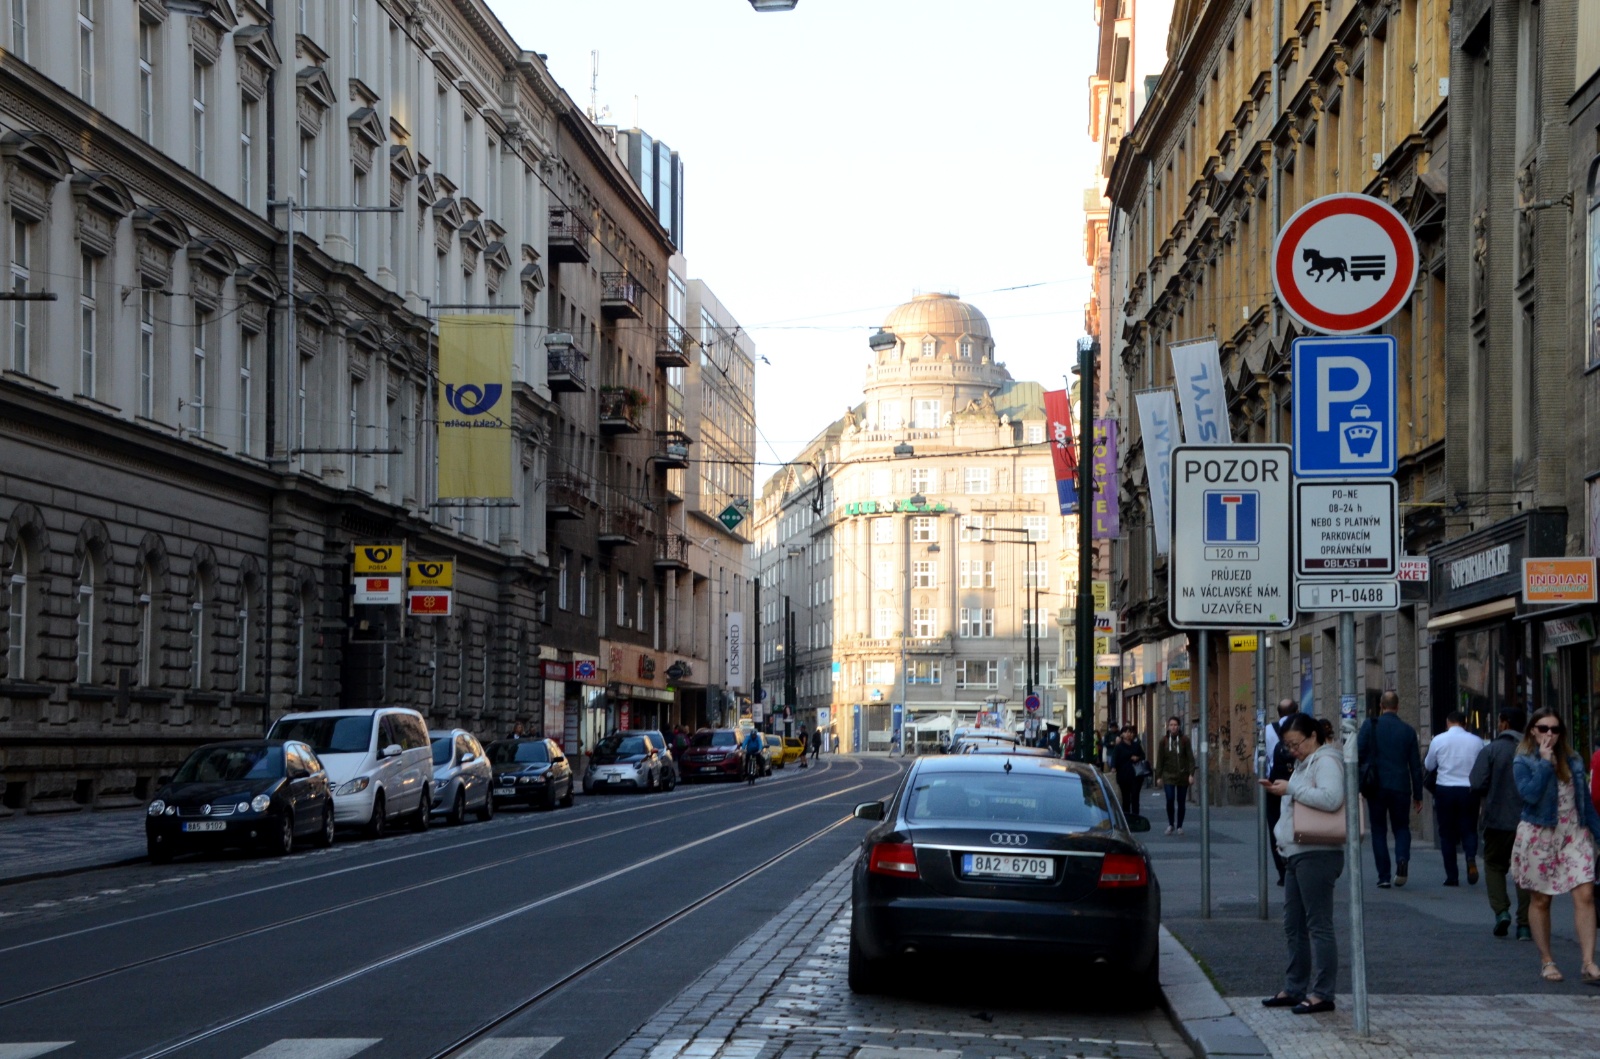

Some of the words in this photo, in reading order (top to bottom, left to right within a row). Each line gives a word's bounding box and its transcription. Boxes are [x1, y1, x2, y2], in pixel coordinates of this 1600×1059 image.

[1317, 356, 1371, 432] P
[1191, 363, 1218, 443] STYL
[1185, 459, 1279, 483] POZOR
[1093, 426, 1108, 532] HOSTEL
[1332, 489, 1358, 499] PO-NE
[1328, 503, 1354, 513] 08-24
[1357, 503, 1362, 513] h
[1311, 518, 1332, 527] NEBO
[1335, 517, 1341, 526] S
[1344, 515, 1381, 526] PLATNÝM
[1321, 529, 1371, 541] PARKOVACÍM
[1215, 549, 1234, 559] 120
[1237, 551, 1249, 559] m
[1320, 543, 1372, 555] OPRÁVNĚNÍM
[1323, 560, 1361, 568] OBLAST
[1365, 560, 1369, 568] 1
[1451, 543, 1511, 590] SUPERMARKET
[1211, 566, 1252, 581] PRŮJEZD
[1396, 570, 1428, 580] RKET
[1530, 574, 1588, 585] INDIAN
[1182, 586, 1195, 598] NA
[1201, 583, 1253, 598] VÁCLAVSKÉ
[1258, 583, 1281, 598] NÁM.
[1331, 588, 1383, 603] P1-0488
[1201, 600, 1263, 615] UZAVŘEN
[730, 624, 740, 675] DESIRRED
[975, 856, 1001, 871] 8A2
[1012, 858, 1047, 873] 6709
